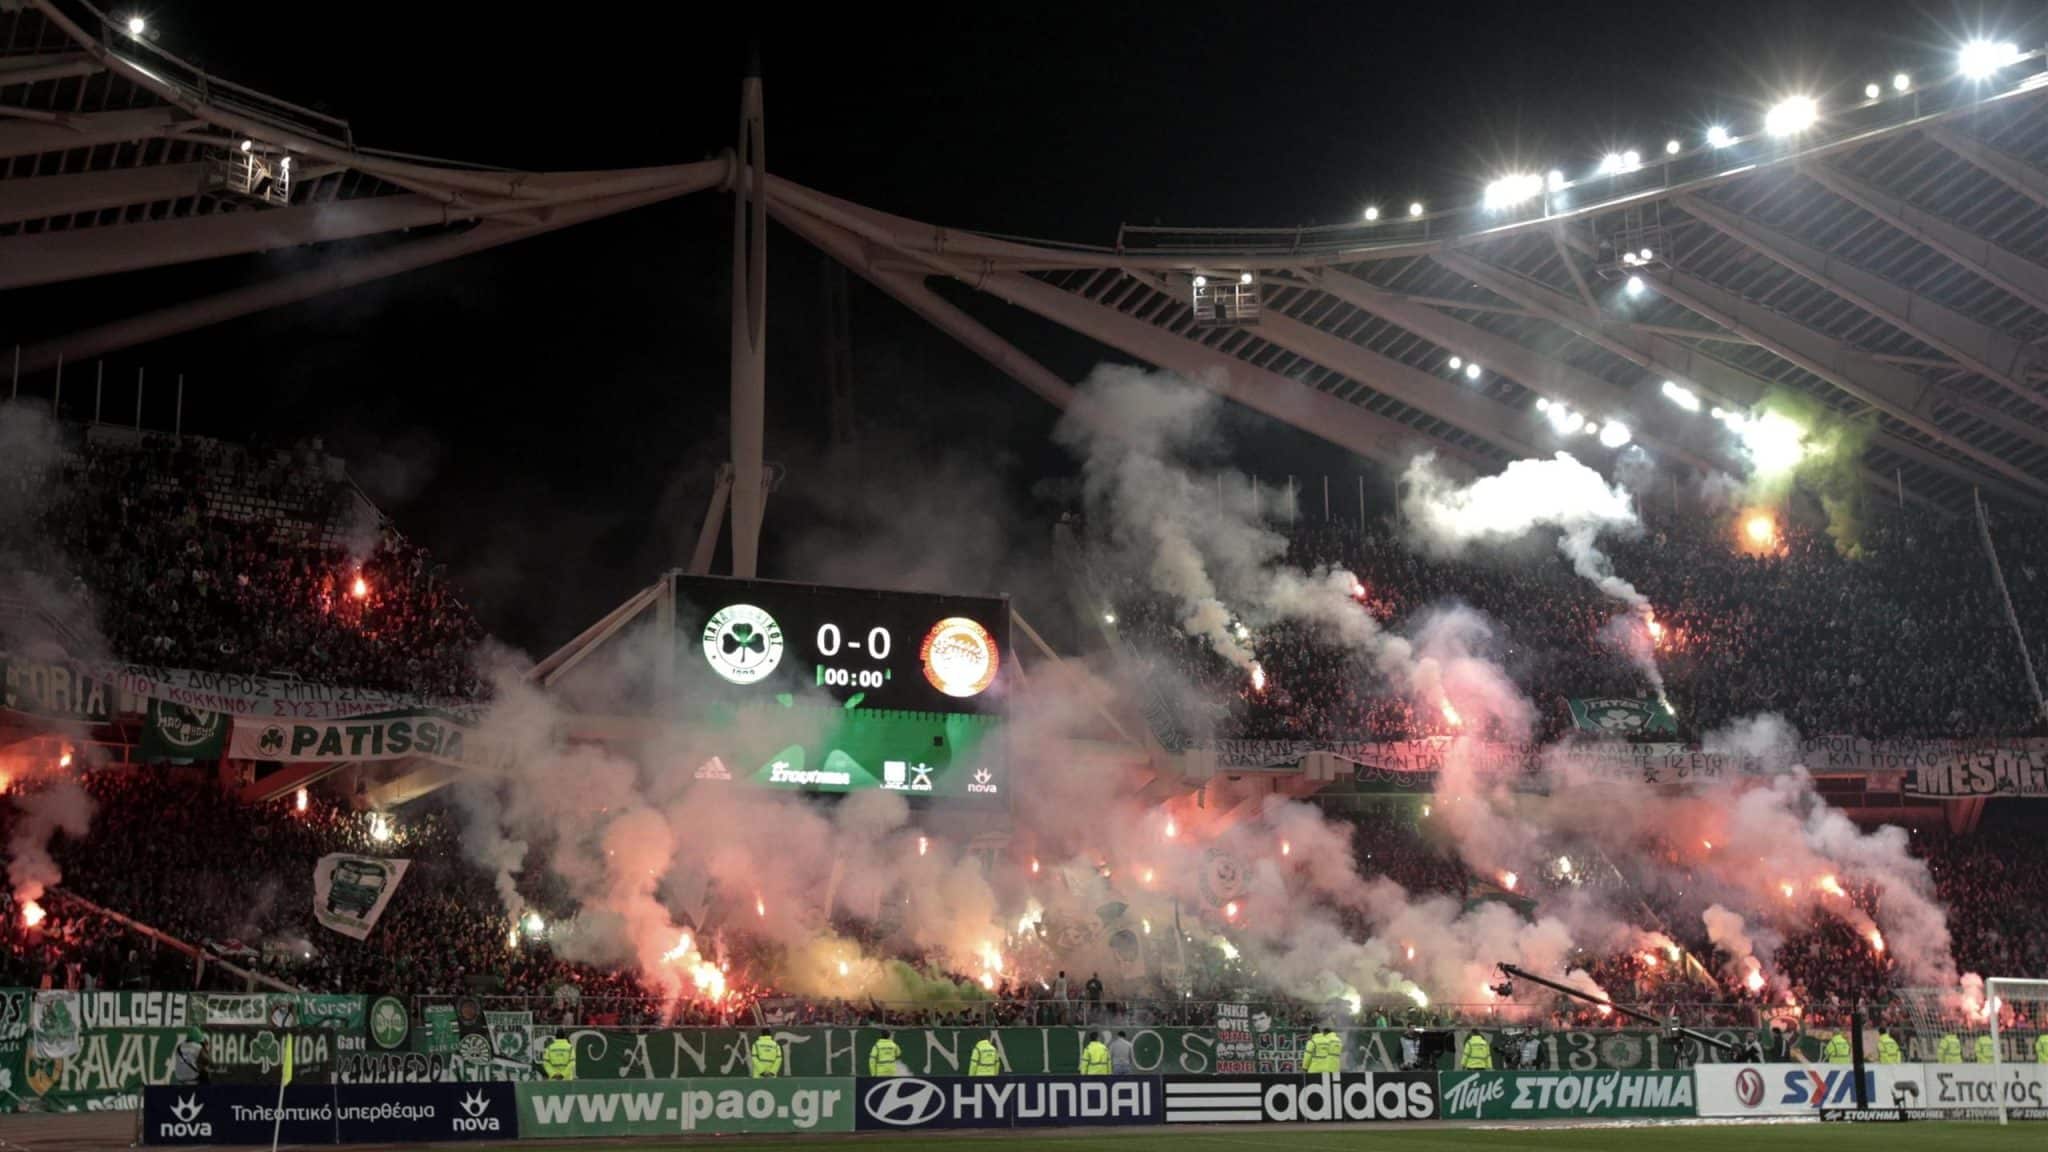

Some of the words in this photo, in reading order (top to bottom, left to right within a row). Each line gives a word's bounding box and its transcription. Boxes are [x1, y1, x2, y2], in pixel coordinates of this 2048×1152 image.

[825, 668, 883, 688] 00:00
[953, 1082, 1150, 1118] HYUNDAI
[1264, 1072, 1434, 1120] adidas
[1443, 1072, 1505, 1119] Πάμε
[1938, 1070, 2042, 1107] Σπαός
[336, 1104, 435, 1124] υπερθέαμα
[452, 1116, 500, 1131] nova
[532, 1089, 841, 1130] www.pao.gr
[161, 1123, 212, 1137] nova
